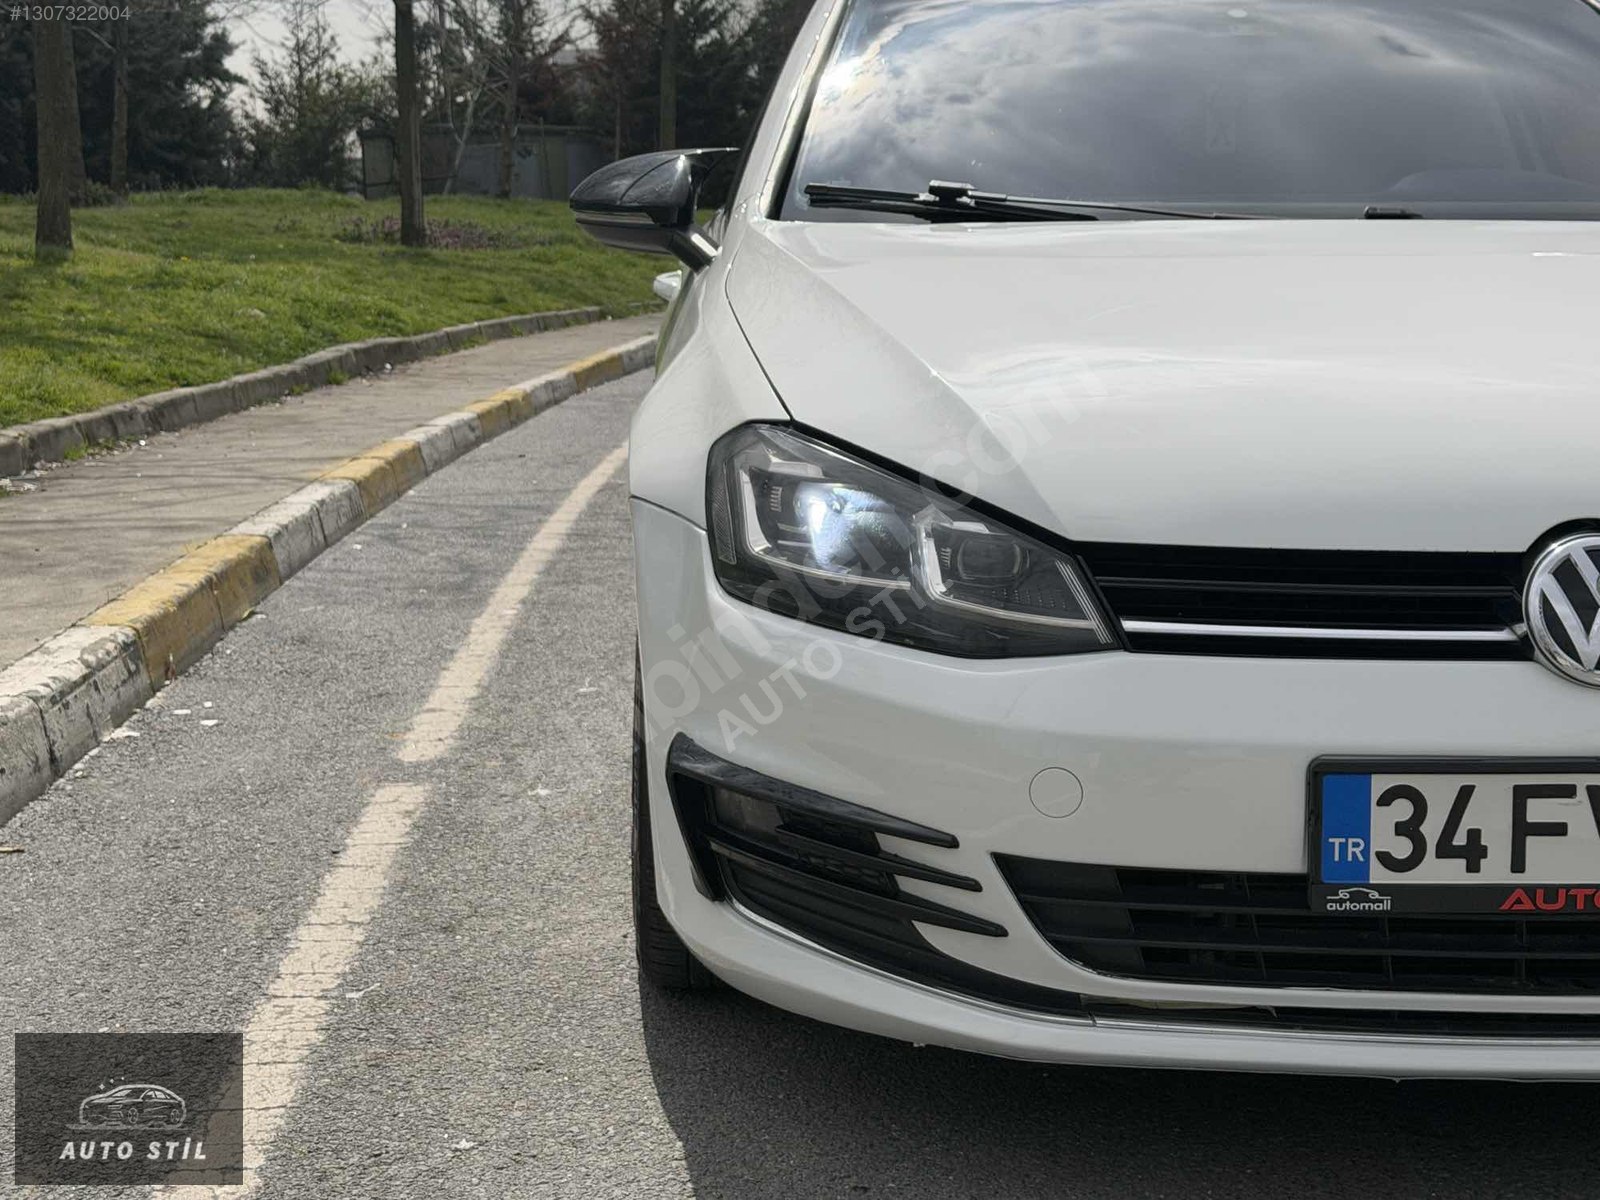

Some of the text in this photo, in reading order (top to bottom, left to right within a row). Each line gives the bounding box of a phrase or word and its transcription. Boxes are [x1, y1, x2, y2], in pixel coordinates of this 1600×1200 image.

[1374, 784, 1488, 873] 34
[1328, 837, 1366, 862] TR
[1326, 900, 1391, 911] automall
